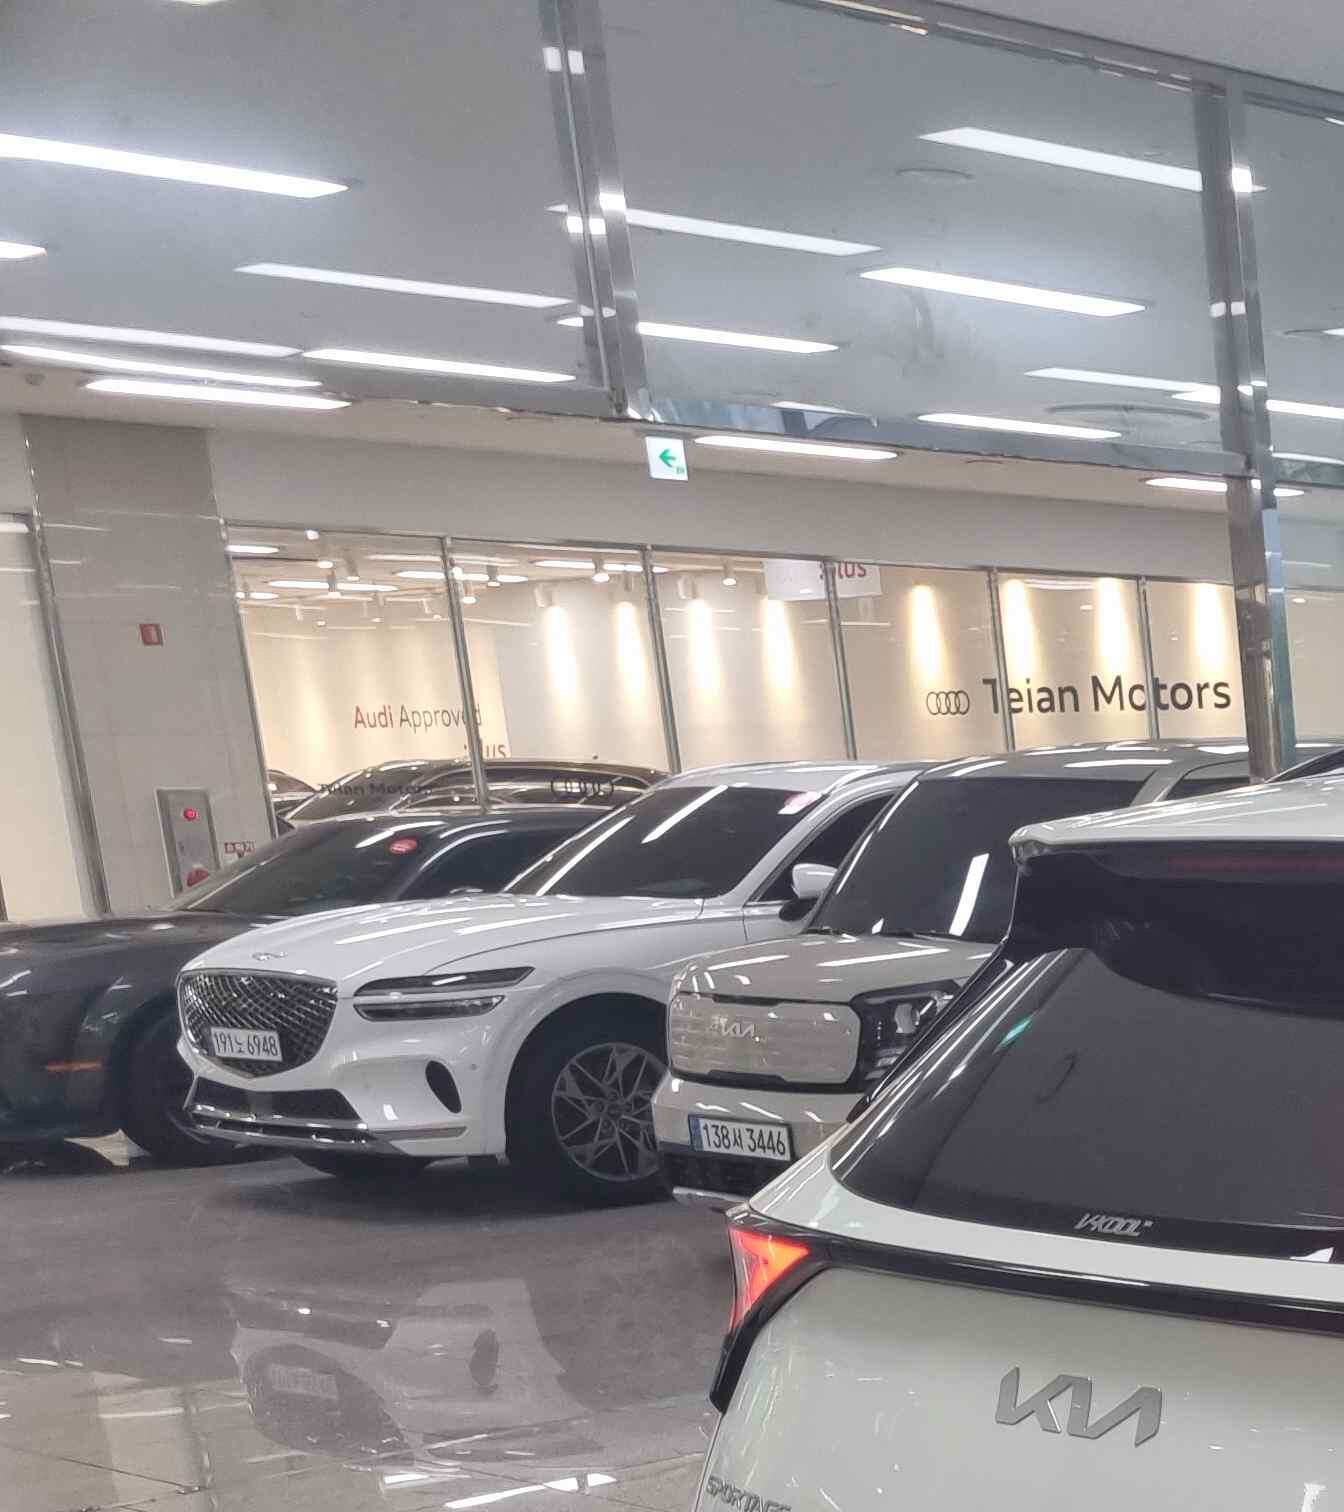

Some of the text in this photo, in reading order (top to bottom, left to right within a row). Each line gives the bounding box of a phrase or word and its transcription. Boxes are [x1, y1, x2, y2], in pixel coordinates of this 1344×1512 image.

[982, 674, 1231, 714] Teian Motors
[354, 704, 394, 729] Audi
[247, 1034, 279, 1057] 6948
[745, 1128, 787, 1156] 3446
[995, 1366, 1163, 1448] KIA
